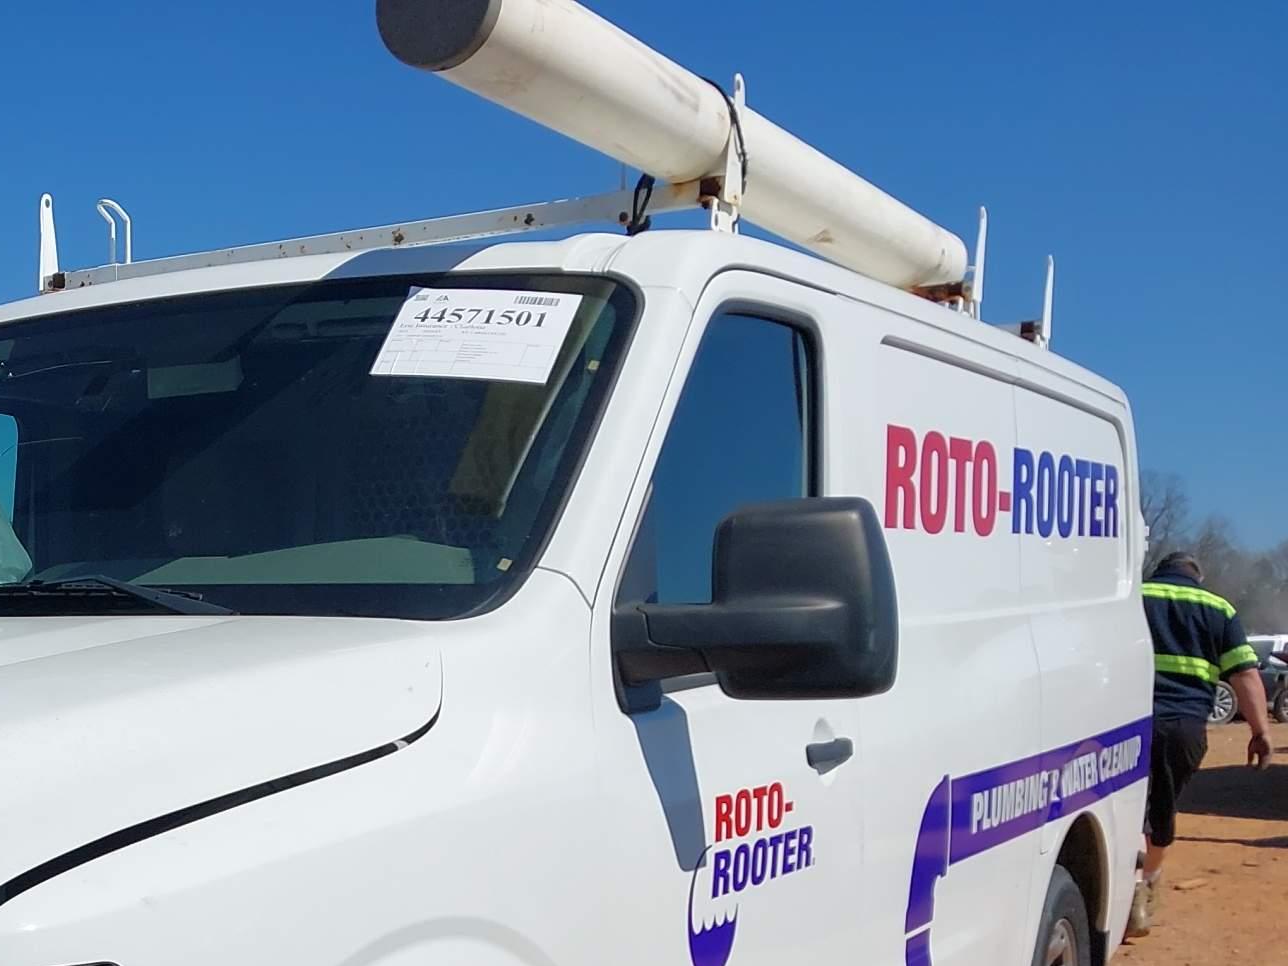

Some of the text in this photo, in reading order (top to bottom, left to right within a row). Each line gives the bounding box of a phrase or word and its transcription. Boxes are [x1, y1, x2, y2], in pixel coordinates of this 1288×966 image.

[414, 307, 548, 327] 44571501
[884, 423, 1119, 538] ROTO-ROOTER
[714, 782, 794, 843] ROTO-
[971, 770, 1049, 835] PLUMBING
[1061, 752, 1099, 798] WATER
[711, 826, 813, 899] ROOTER
